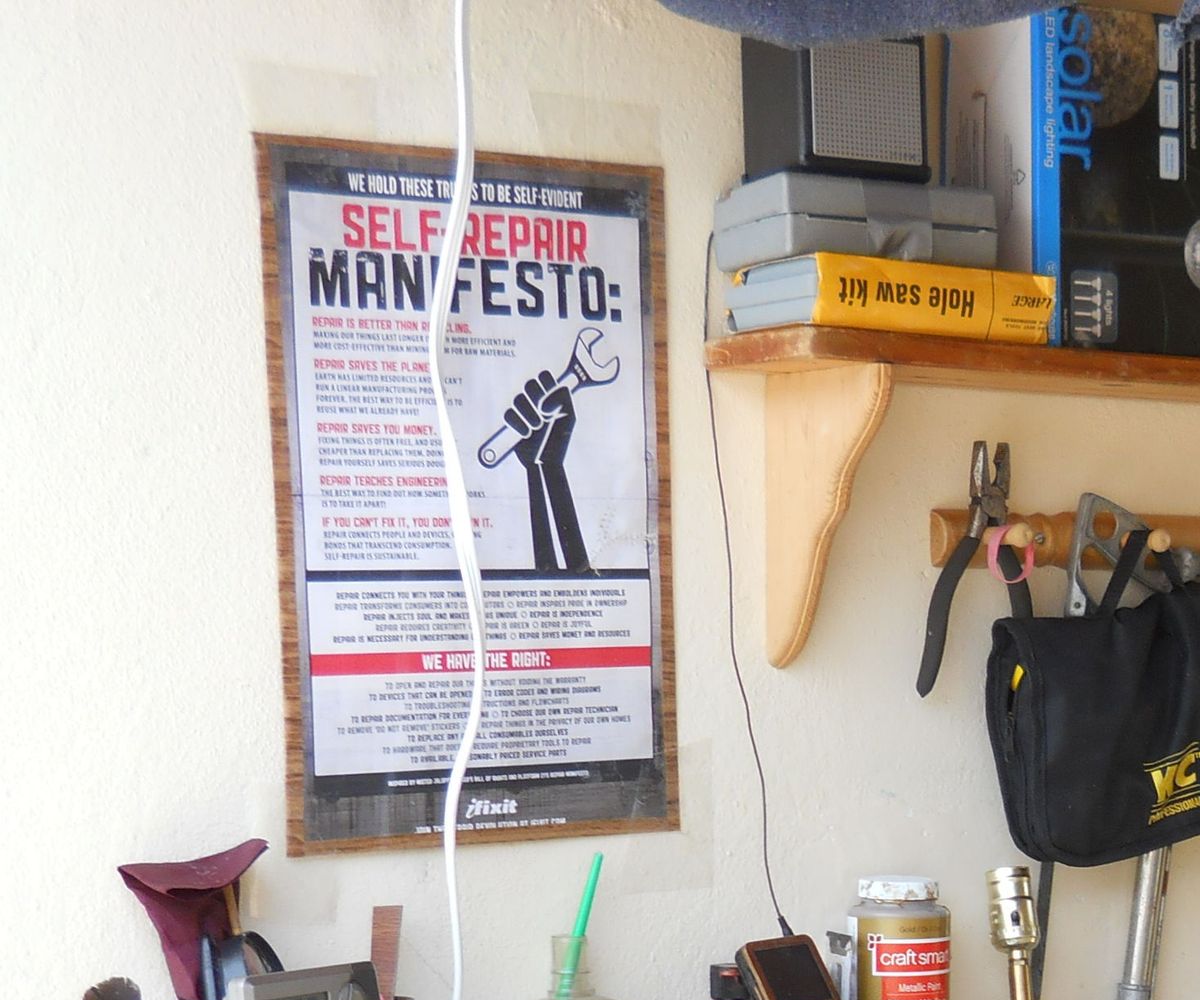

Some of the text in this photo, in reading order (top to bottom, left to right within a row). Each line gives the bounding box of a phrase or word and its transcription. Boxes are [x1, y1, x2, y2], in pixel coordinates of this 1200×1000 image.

[1043, 42, 1056, 114] landscape
[1059, 11, 1103, 171] solar
[1043, 119, 1056, 168] lighting
[348, 172, 583, 210] WE HOLD THESE TRUS TO BE SELF-EVIDENT
[838, 277, 975, 318] Hole saw kit
[1104, 300, 1114, 325] lights
[313, 317, 343, 328] REPAIR
[397, 320, 418, 331] THAN
[314, 359, 344, 370] REPAIR
[382, 361, 397, 372] THE
[402, 361, 430, 373] PLANE
[317, 423, 348, 433] REPAIR
[352, 424, 380, 434] SAVES
[384, 424, 400, 434] YOU
[320, 476, 350, 485] REPAIR
[397, 476, 448, 487] ENGINEERIN
[322, 517, 329, 527] IF
[334, 517, 350, 527] YOU
[382, 518, 395, 527] FIX
[413, 518, 429, 527] YOU
[421, 650, 551, 670] WE HAVE THE RIGHT:
